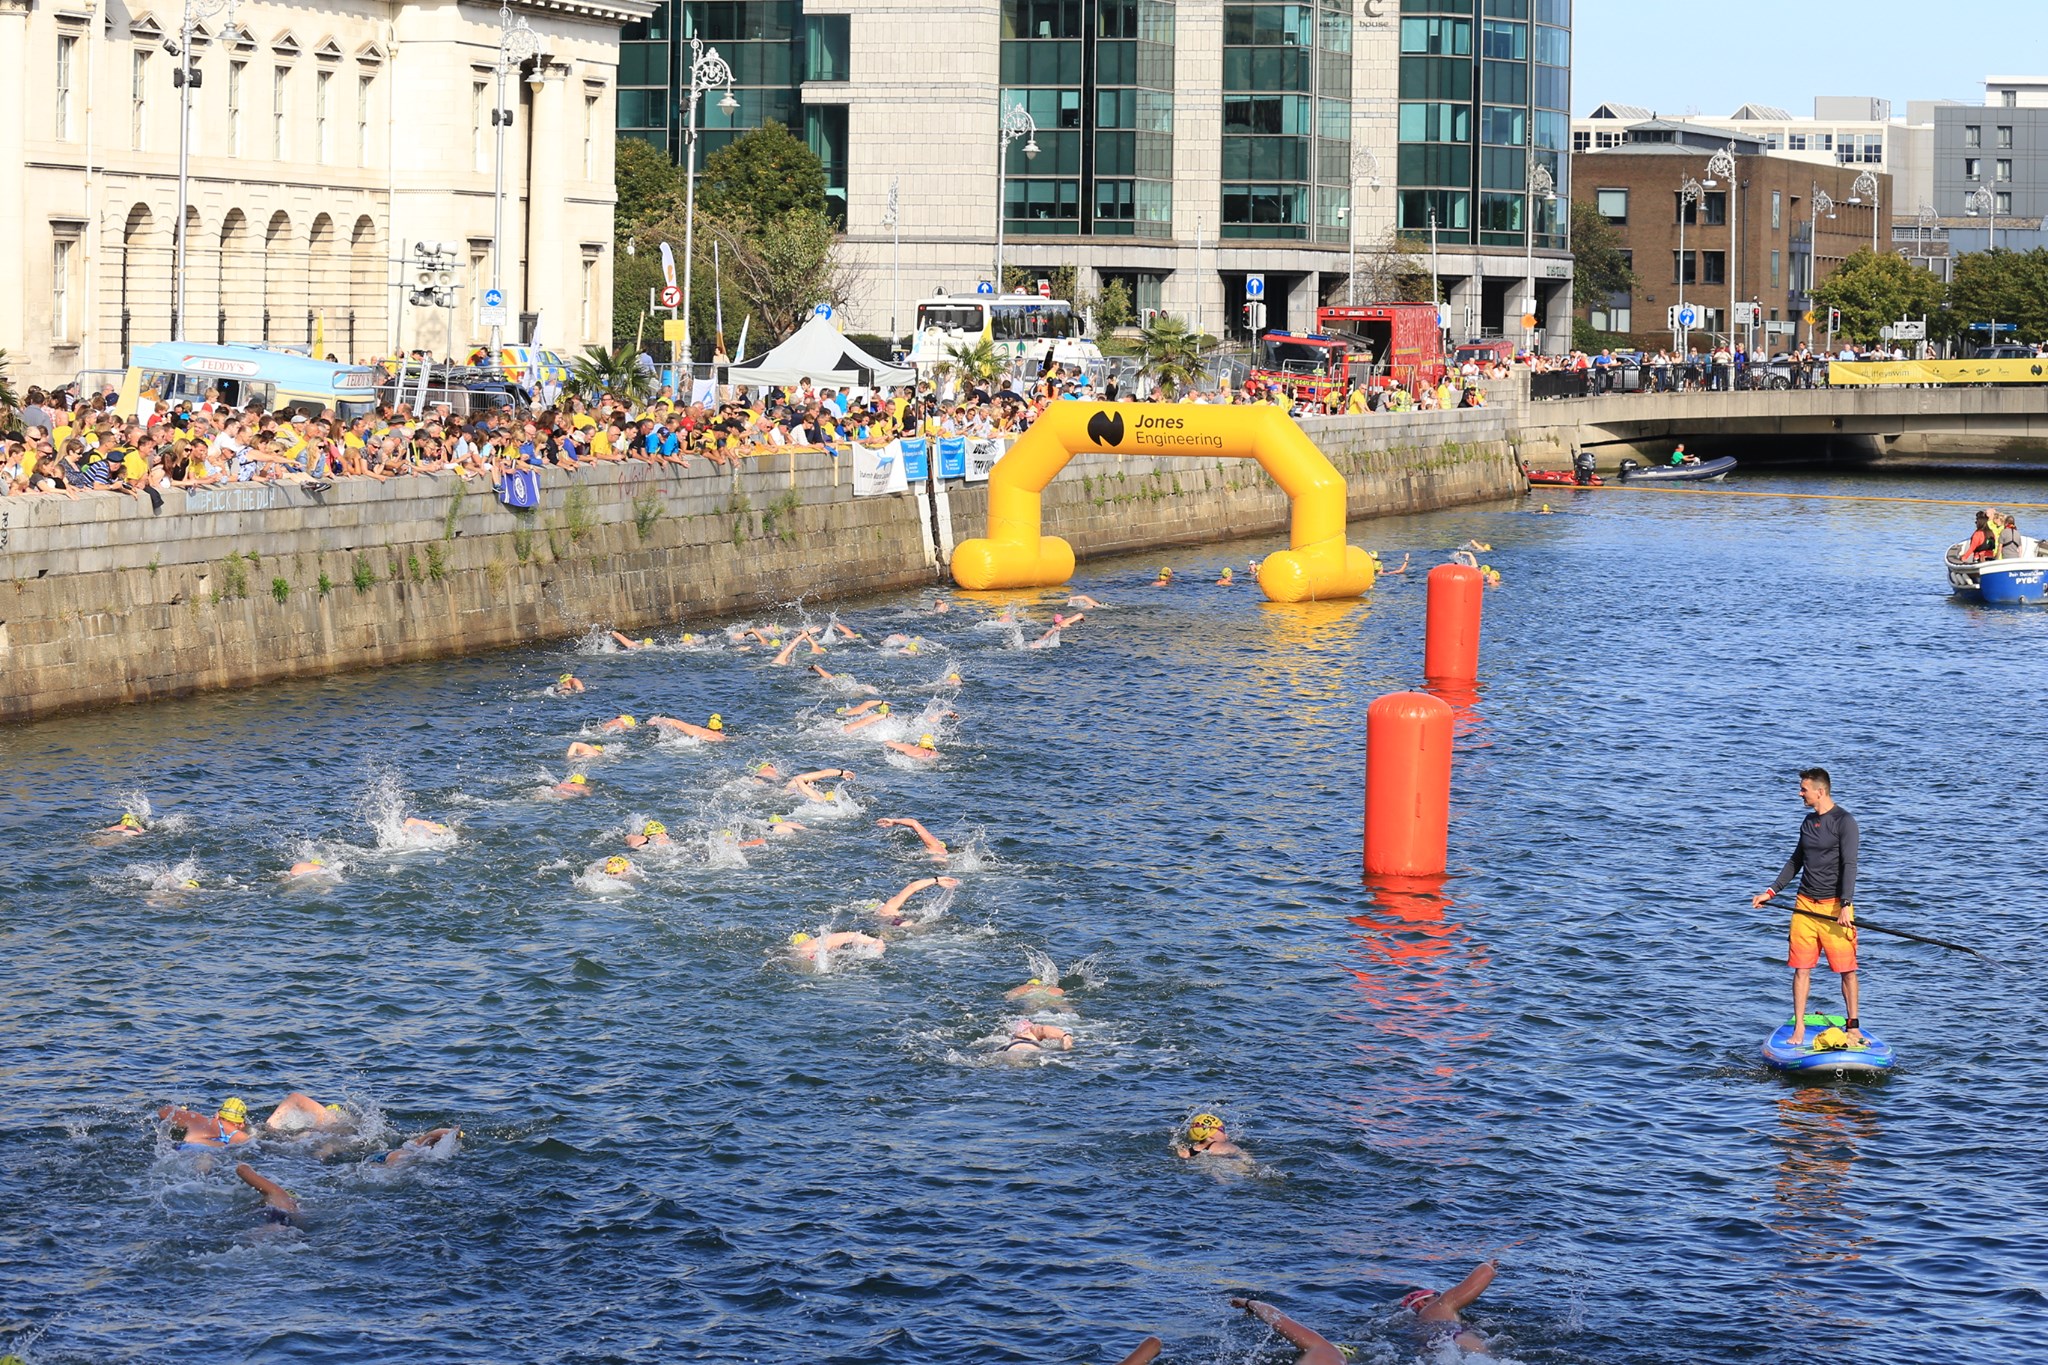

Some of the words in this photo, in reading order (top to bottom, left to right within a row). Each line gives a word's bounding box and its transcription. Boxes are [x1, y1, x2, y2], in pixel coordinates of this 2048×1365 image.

[1359, 20, 1389, 28] house
[201, 360, 246, 373] TEDDY'S
[1135, 414, 1184, 429] Jones
[1136, 431, 1223, 448] Engineering
[206, 490, 232, 512] FUCK
[233, 489, 255, 511] THE
